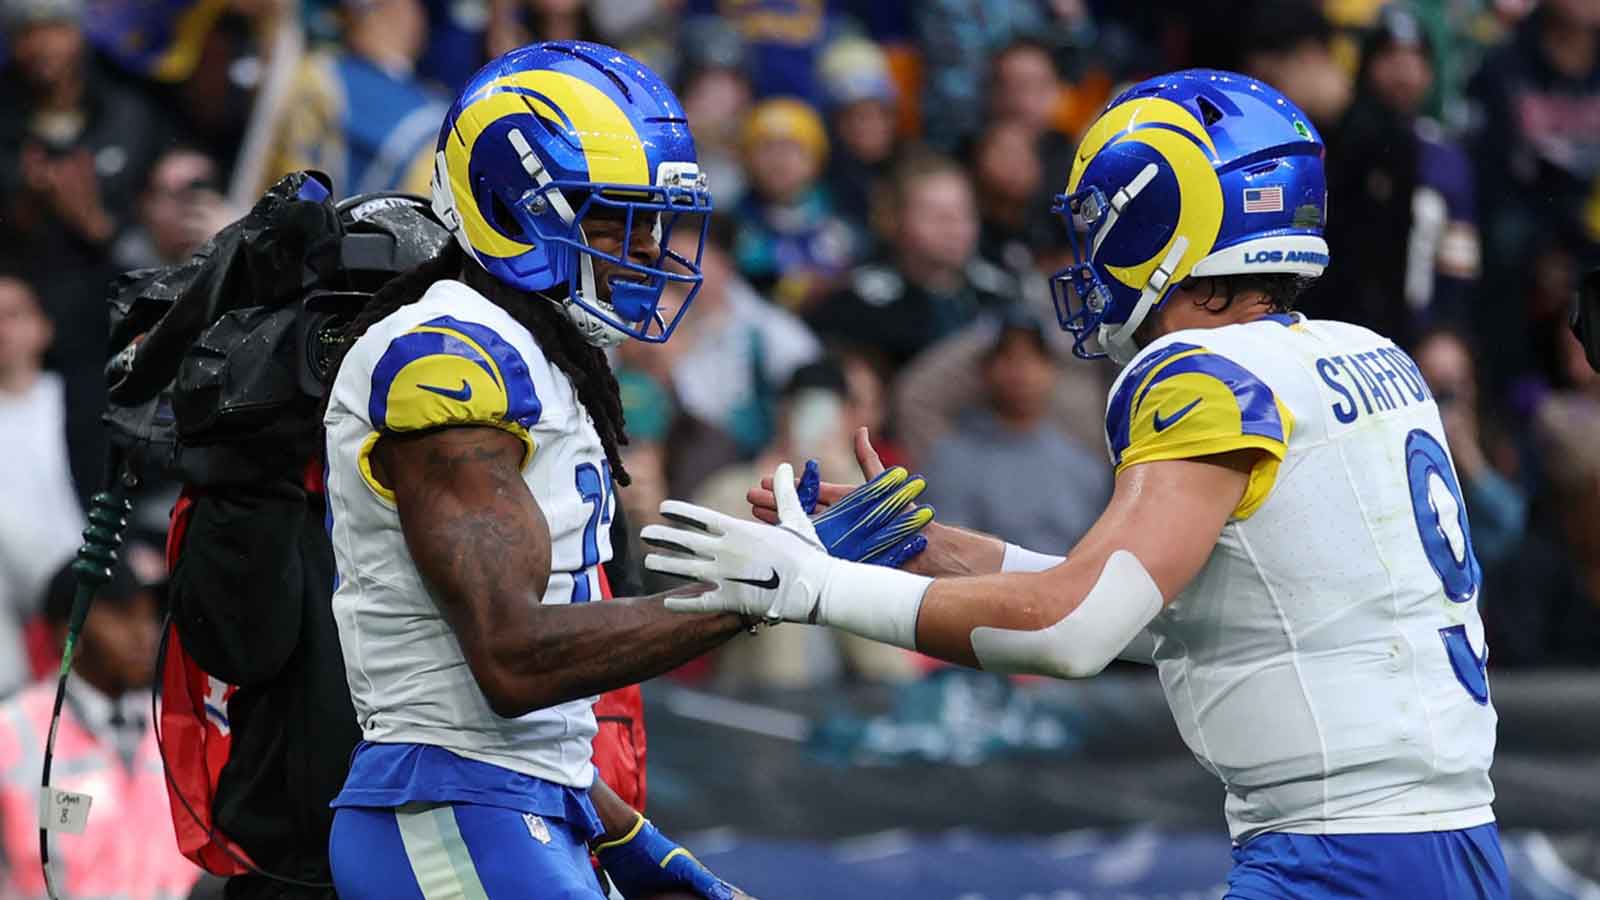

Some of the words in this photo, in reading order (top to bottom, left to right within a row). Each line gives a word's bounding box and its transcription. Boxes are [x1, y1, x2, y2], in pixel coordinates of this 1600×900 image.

[1244, 251, 1283, 264] LOS
[1316, 347, 1431, 424] STAFFOR
[1405, 428, 1488, 705] 9
